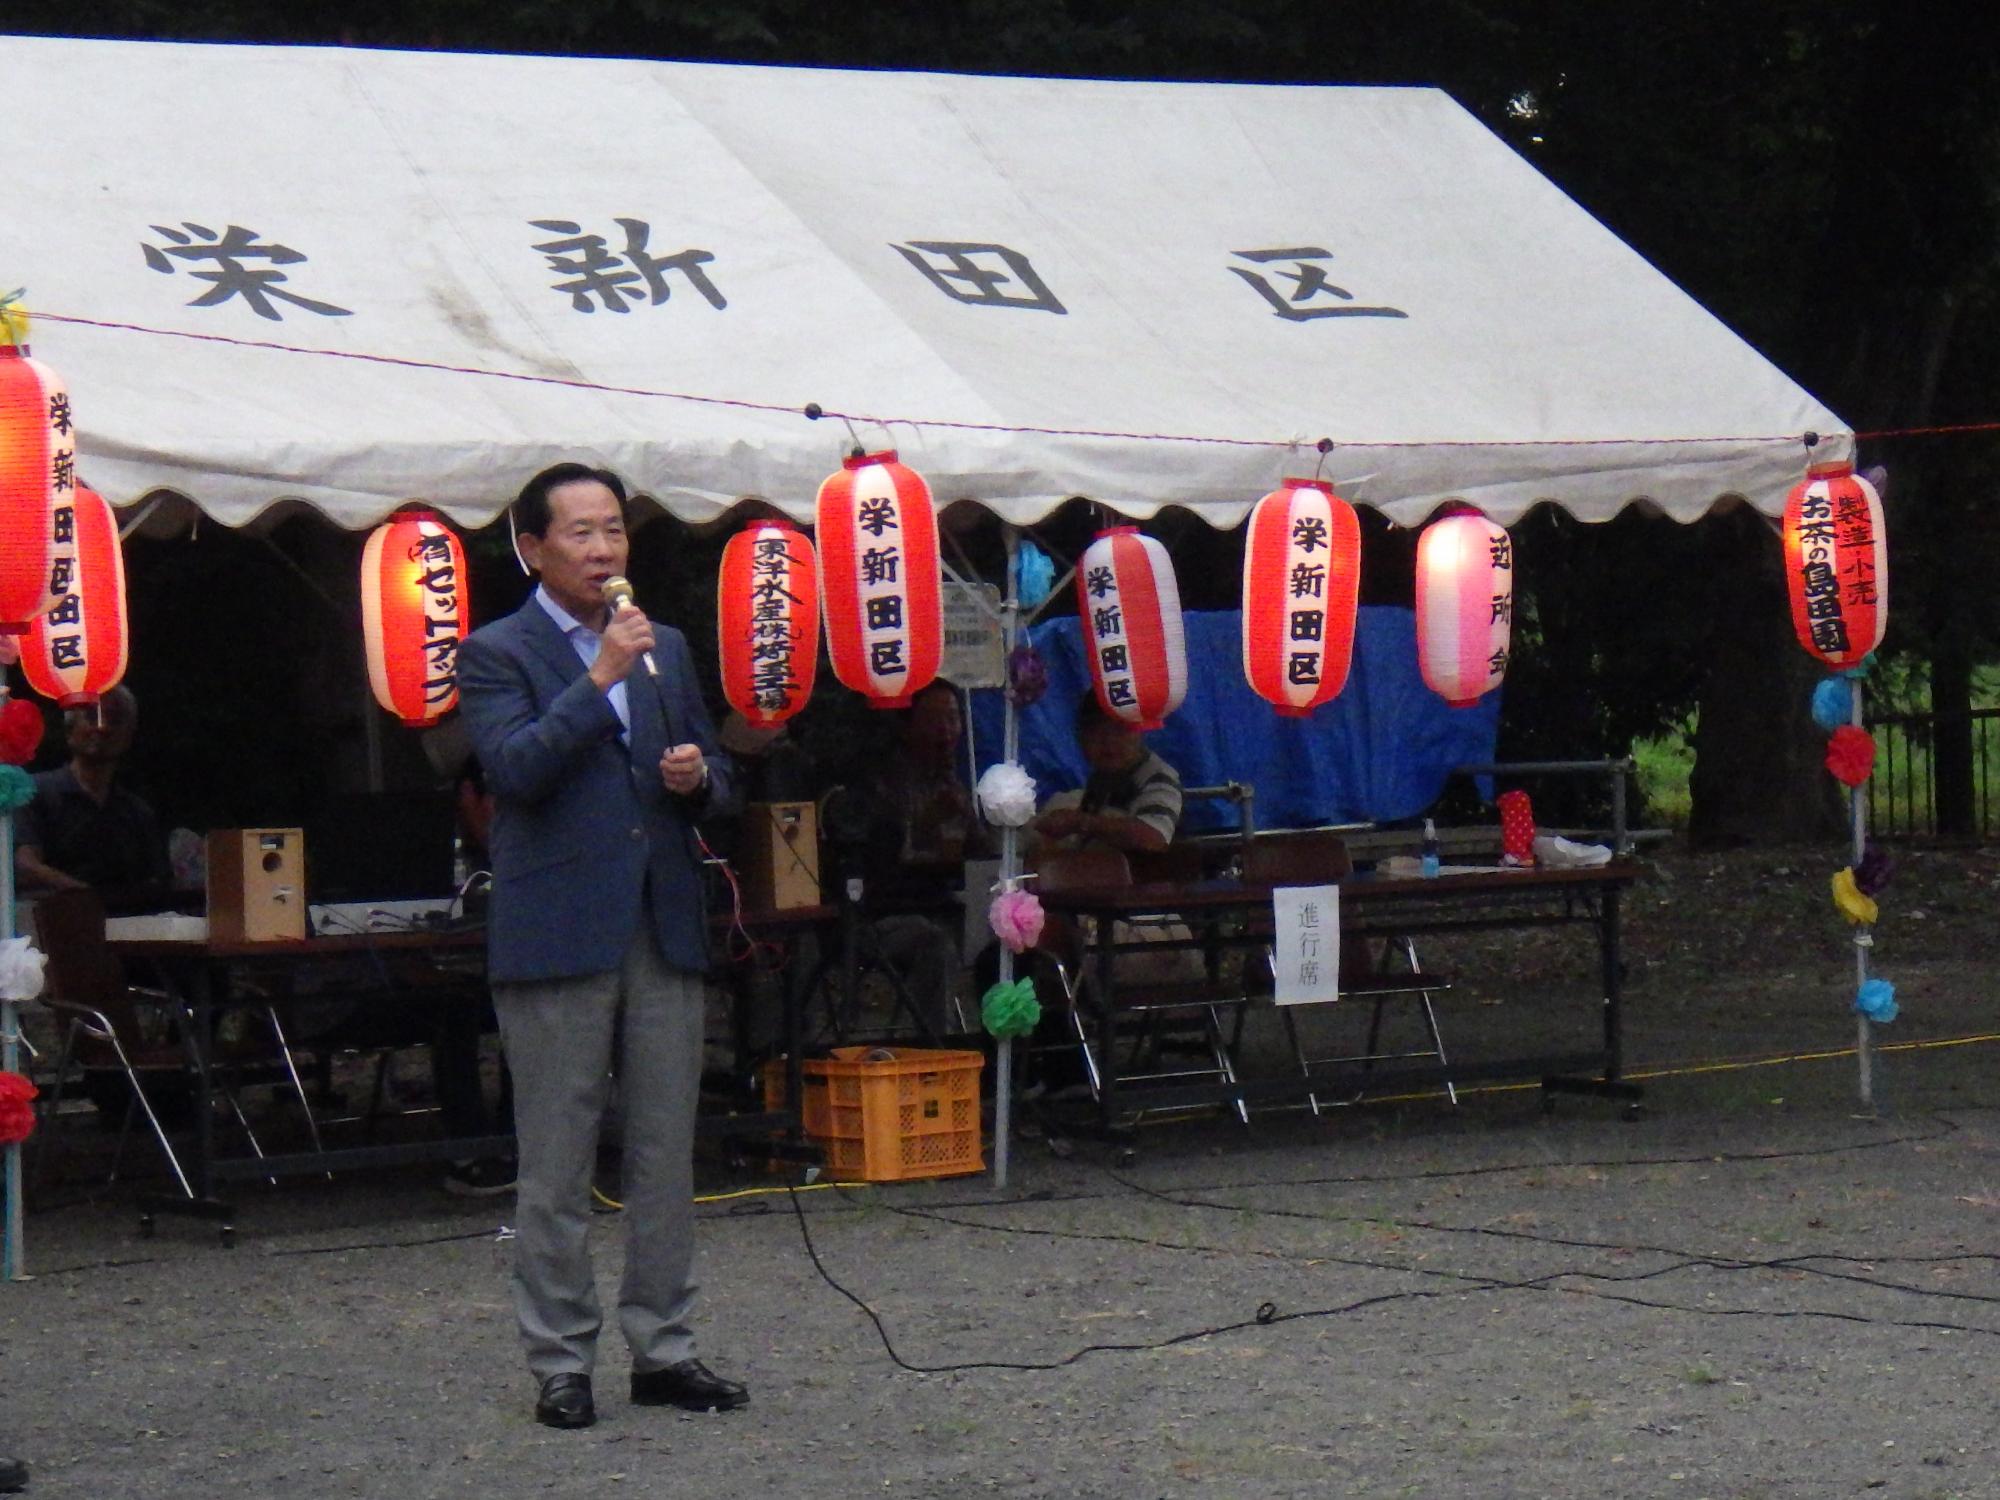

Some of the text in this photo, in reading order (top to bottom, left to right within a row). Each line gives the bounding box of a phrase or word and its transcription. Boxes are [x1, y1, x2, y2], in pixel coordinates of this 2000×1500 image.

[143, 219, 1406, 321] 栄新田区
[50, 392, 74, 594] 栄新田区
[49, 594, 85, 669] 田区
[859, 498, 906, 676] 栄新田区
[1088, 566, 1136, 708] 栄新田区
[1289, 517, 1328, 686] 栄新田区
[1298, 903, 1319, 987] 進行席
